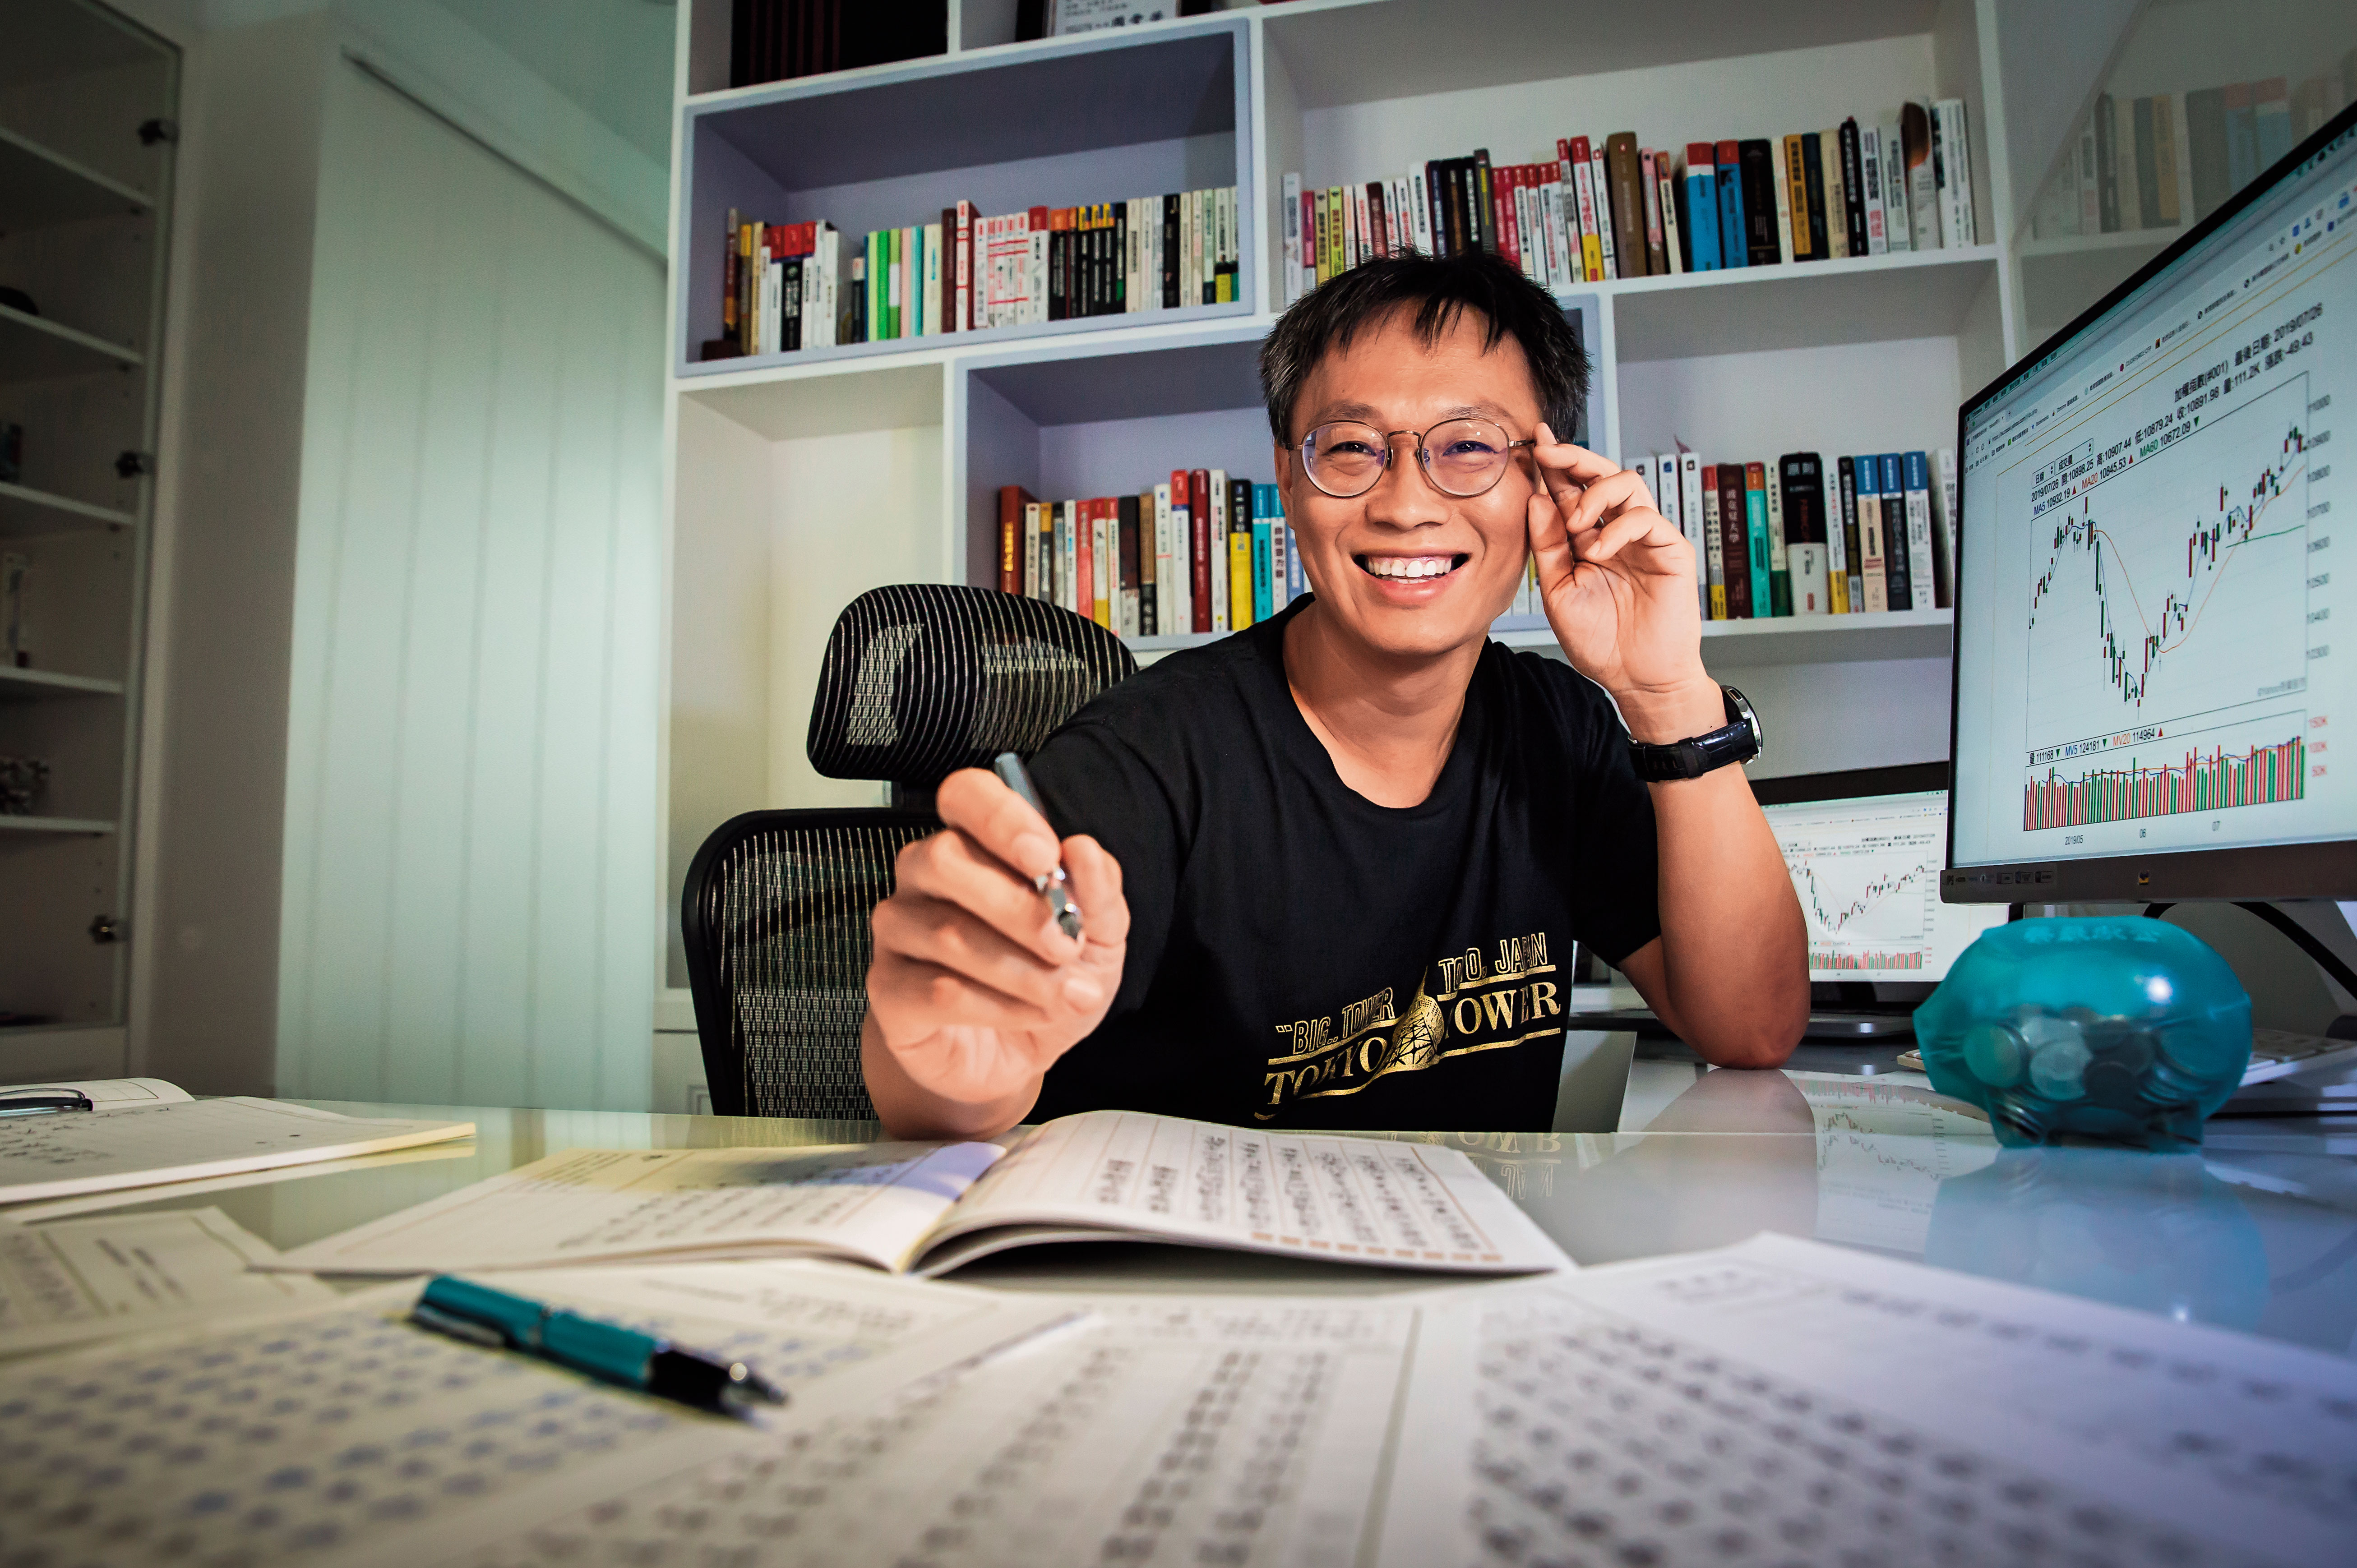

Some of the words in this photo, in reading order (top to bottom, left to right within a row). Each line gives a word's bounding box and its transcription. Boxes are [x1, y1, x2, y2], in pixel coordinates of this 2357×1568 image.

[2031, 479, 2059, 502] 2019/07/26
[2096, 437, 2131, 467] 高:10907.44
[2034, 502, 2045, 516] MA5
[2047, 489, 2070, 509] 10932.19
[2082, 472, 2098, 490] MA20
[2100, 457, 2126, 480] 10845.53
[2140, 439, 2158, 458] MA60
[2160, 421, 2191, 447] 10672.09
[2058, 454, 2073, 470] 成交量
[2029, 752, 2035, 765] 量
[2036, 749, 2053, 762] 111168
[2065, 744, 2077, 756] MV5
[2080, 740, 2099, 754] 124181
[2112, 733, 2131, 746] MV20
[2132, 727, 2155, 742] 114964
[2065, 835, 2083, 845] 2019/05
[1264, 1037, 1388, 1105] TOKYO
